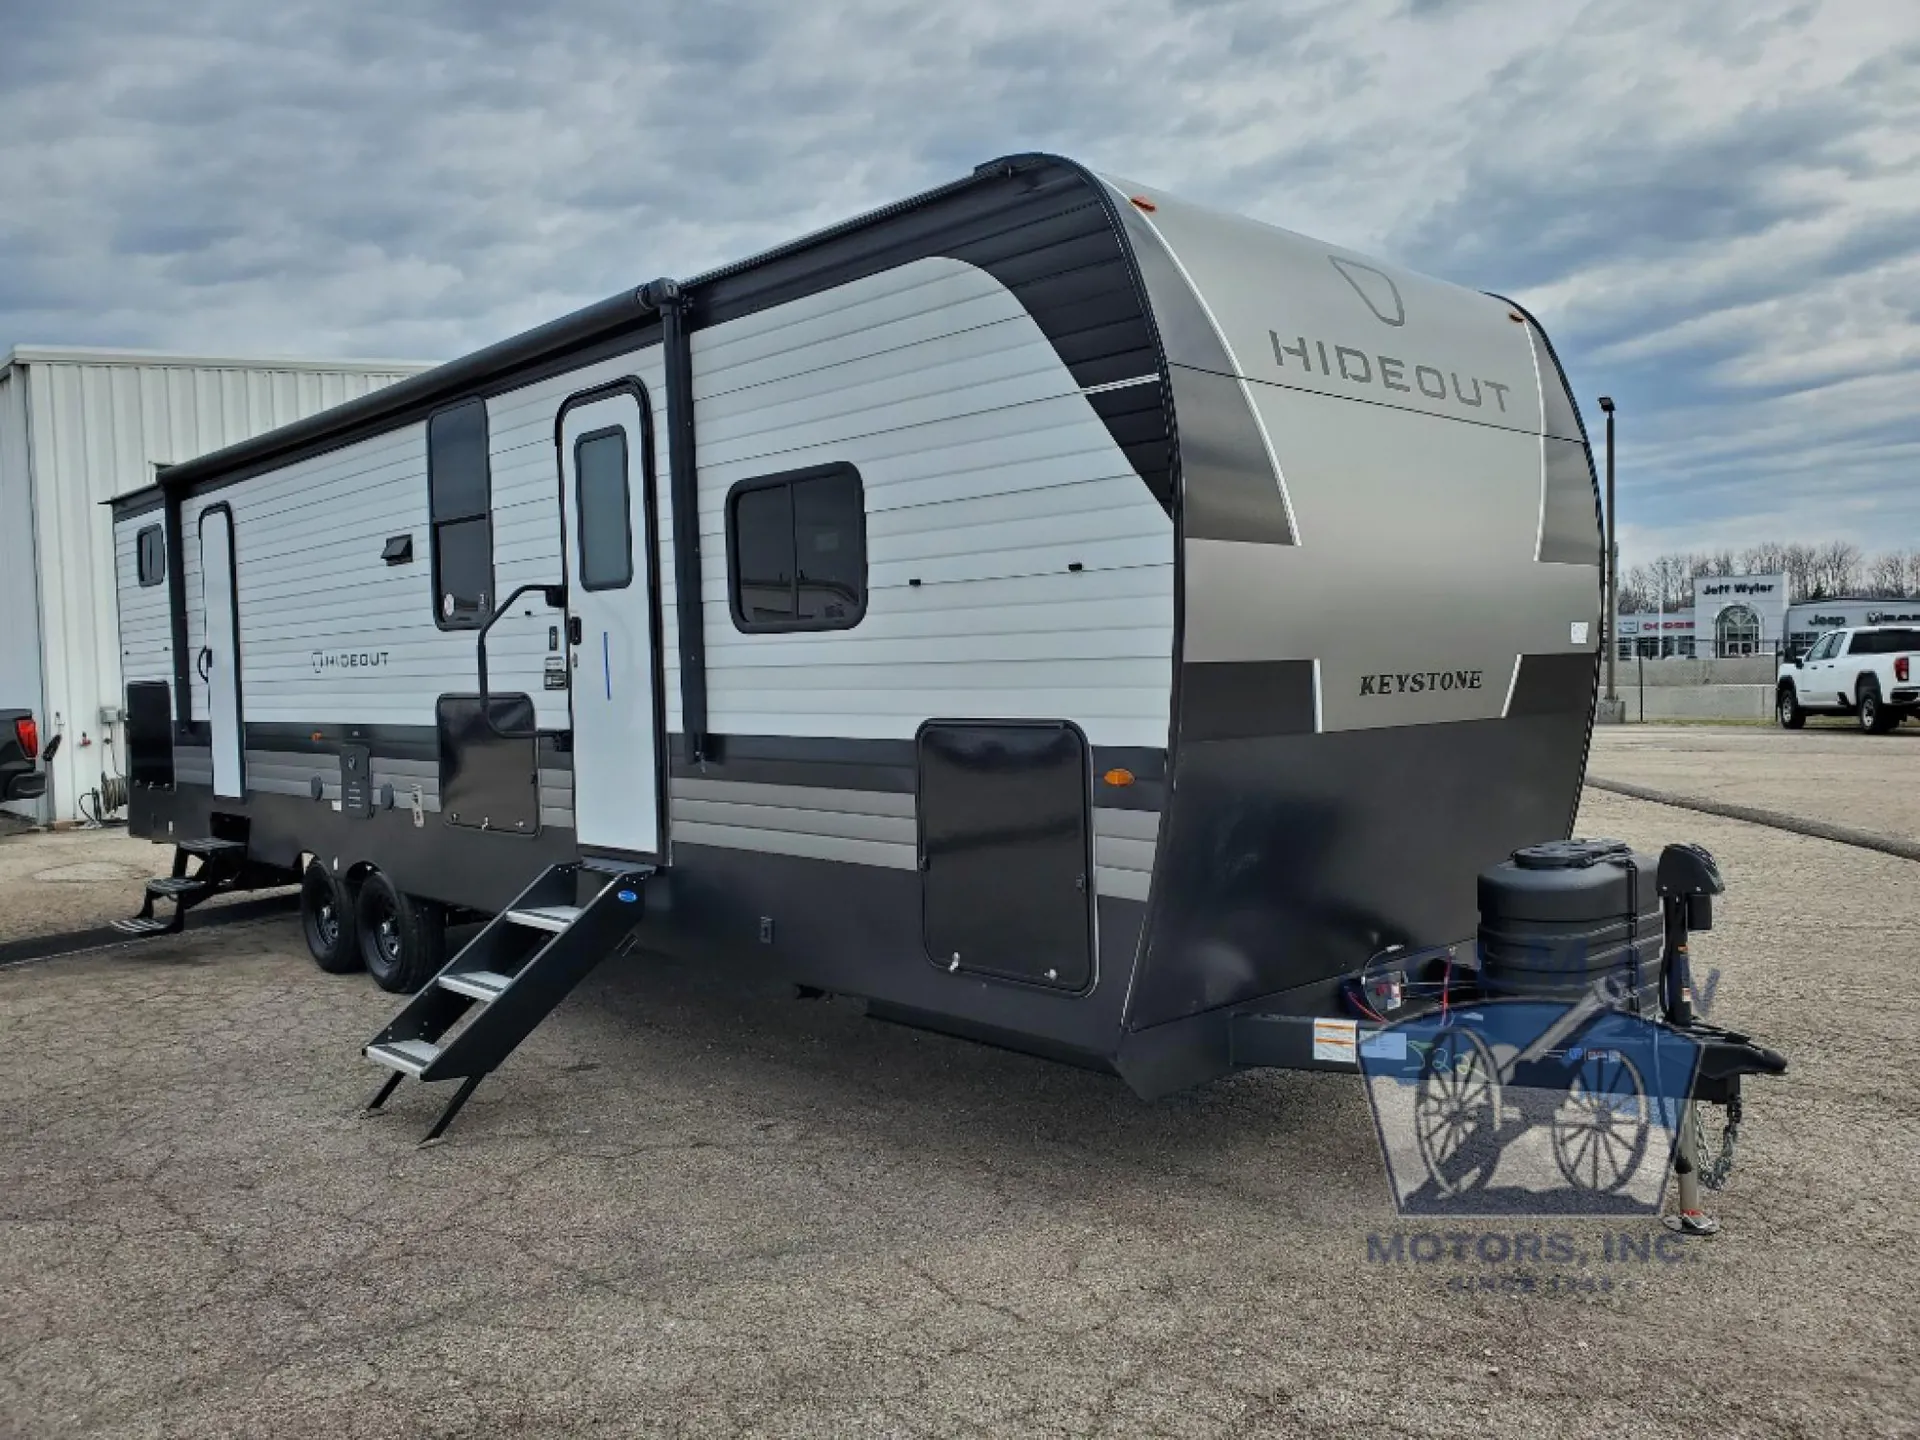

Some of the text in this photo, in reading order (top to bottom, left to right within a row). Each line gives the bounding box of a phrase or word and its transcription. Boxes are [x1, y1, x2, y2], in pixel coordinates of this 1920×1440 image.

[1269, 330, 1510, 412] HIDEOUT
[1702, 582, 1775, 595] Jeff Wyler
[1808, 613, 1846, 626] Jeep
[326, 652, 389, 668] HIDEOUT
[1359, 670, 1483, 696] KEYSTONE
